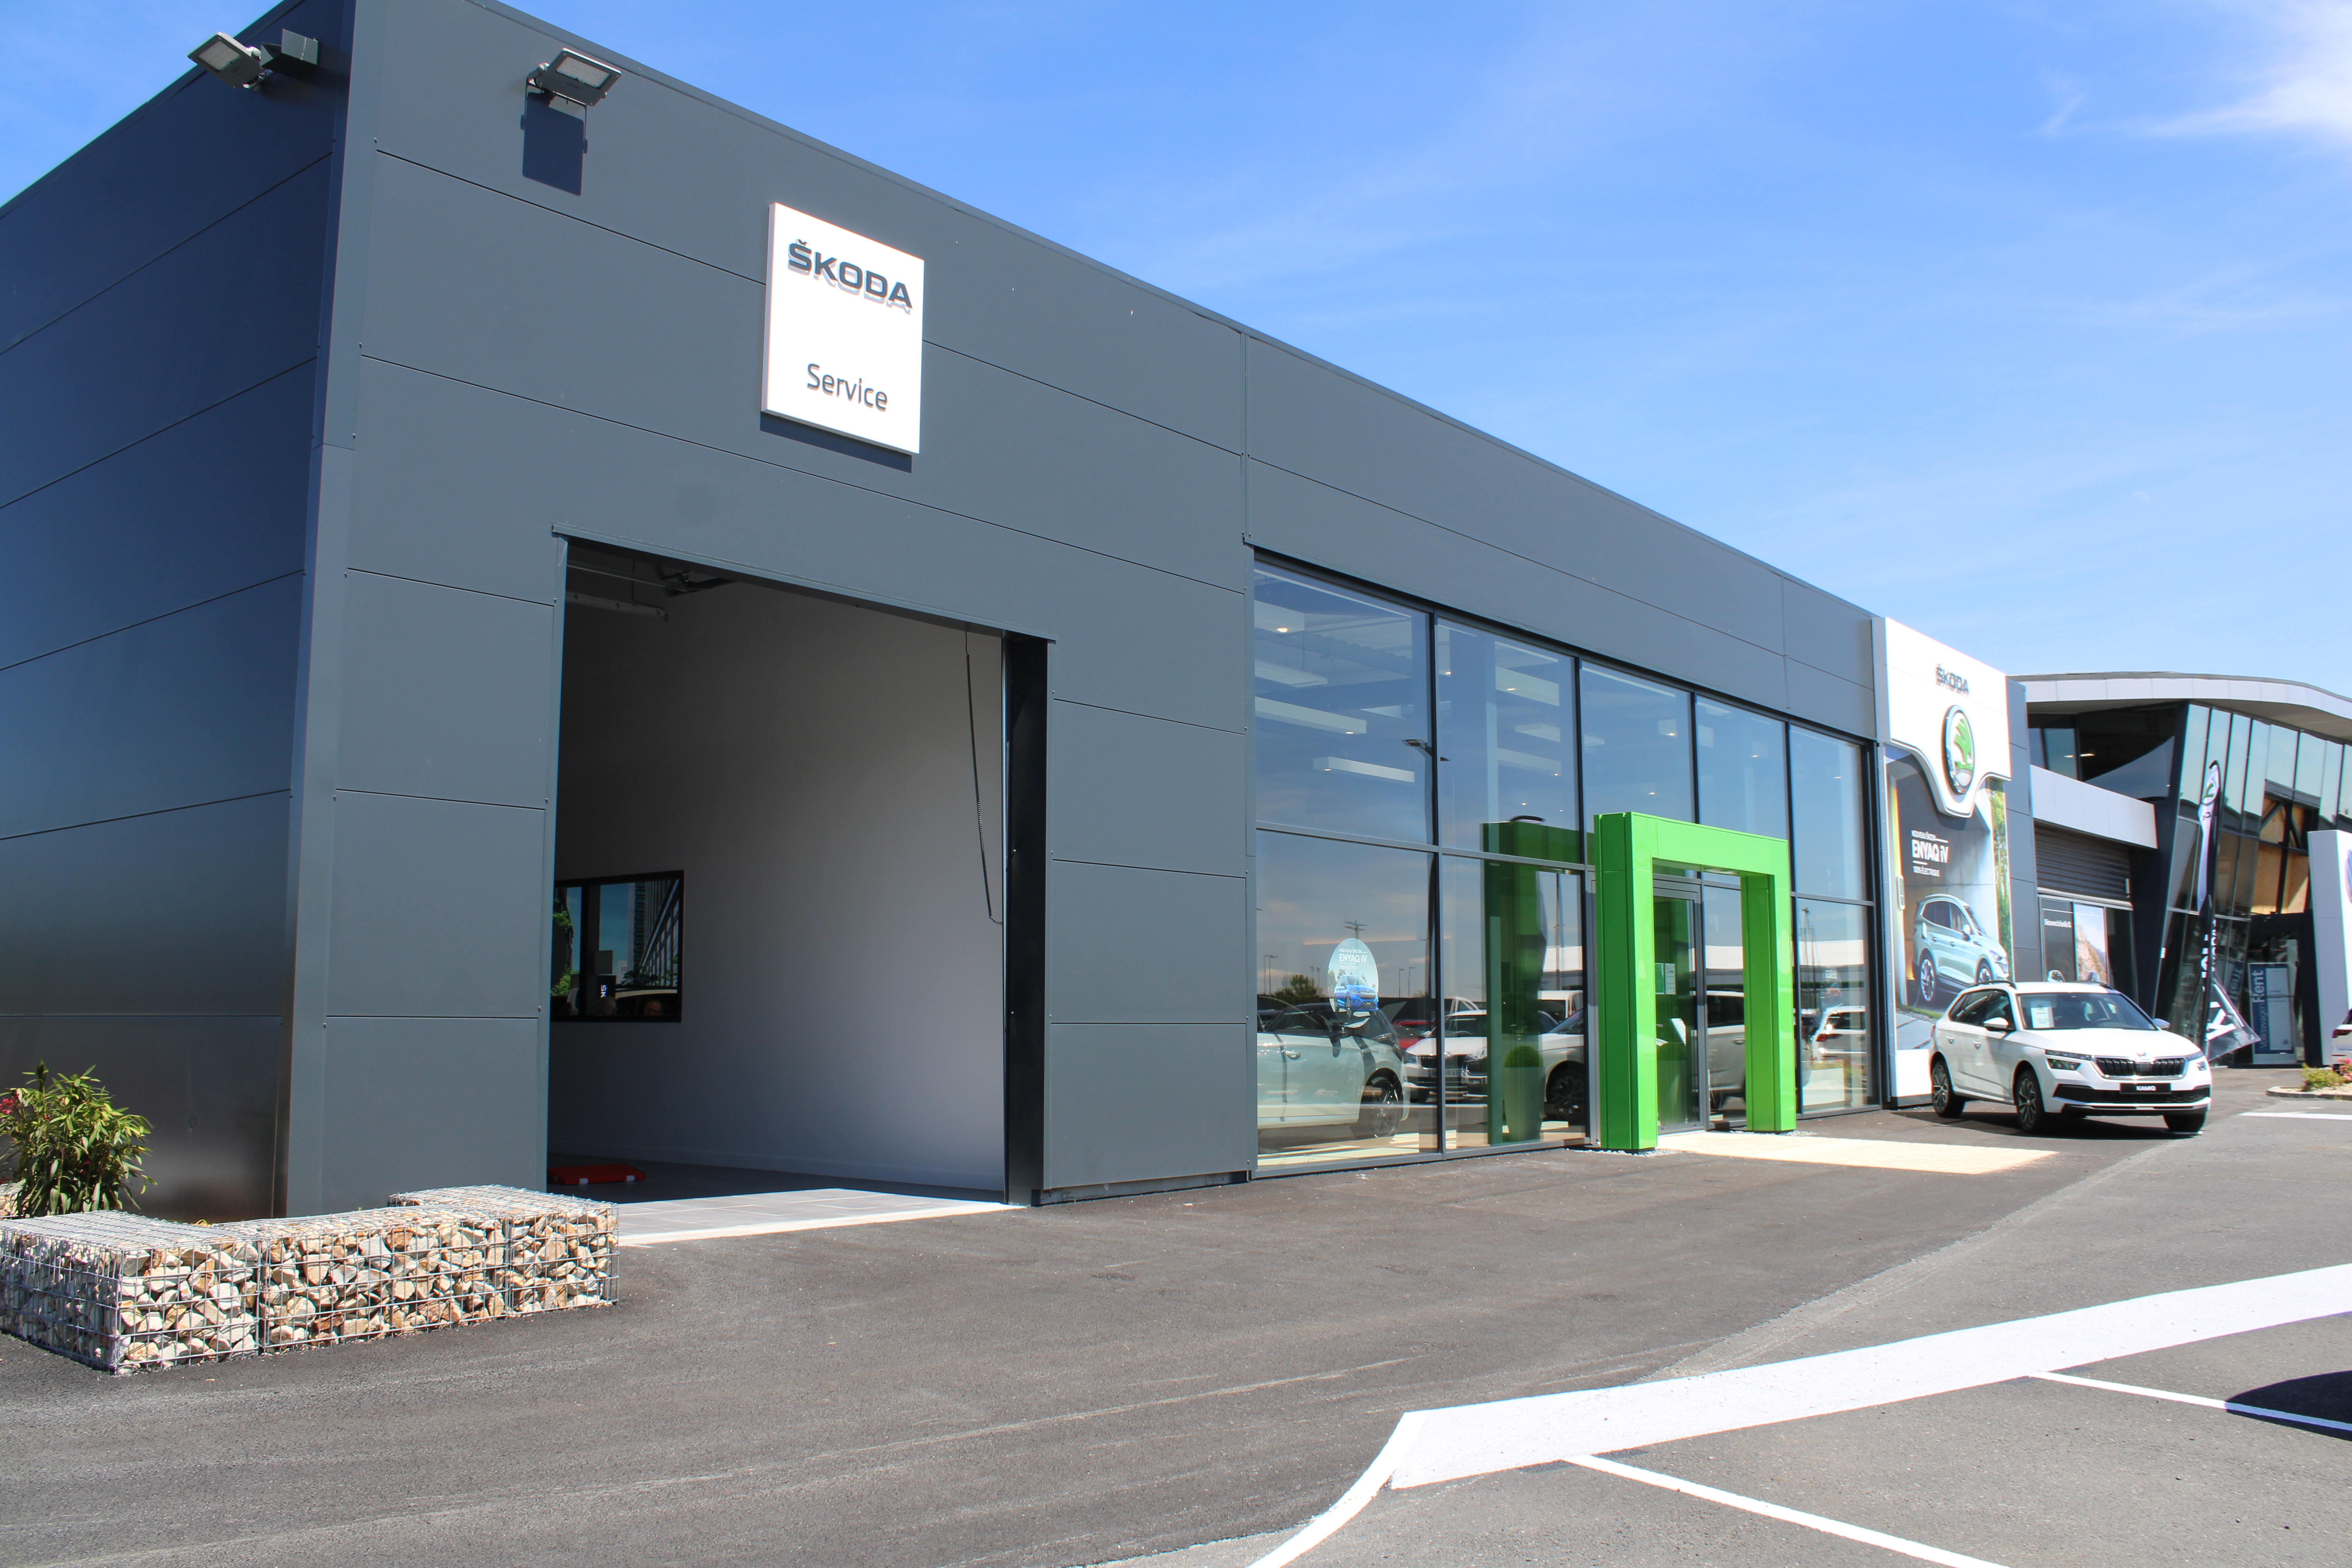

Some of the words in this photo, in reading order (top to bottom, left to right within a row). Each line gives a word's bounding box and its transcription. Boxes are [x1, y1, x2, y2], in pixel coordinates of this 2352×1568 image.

[788, 239, 913, 312] ŠKODA
[807, 363, 888, 411] Service
[1935, 663, 1969, 696] ŠKODA
[1911, 839, 1940, 862] ENYAQ
[1940, 845, 1949, 863] iV
[1339, 953, 1360, 963] ENYAQ
[1361, 955, 1367, 963] iV
[2252, 970, 2265, 1003] Rent
[2259, 1003, 2268, 1049] Volkswagen
